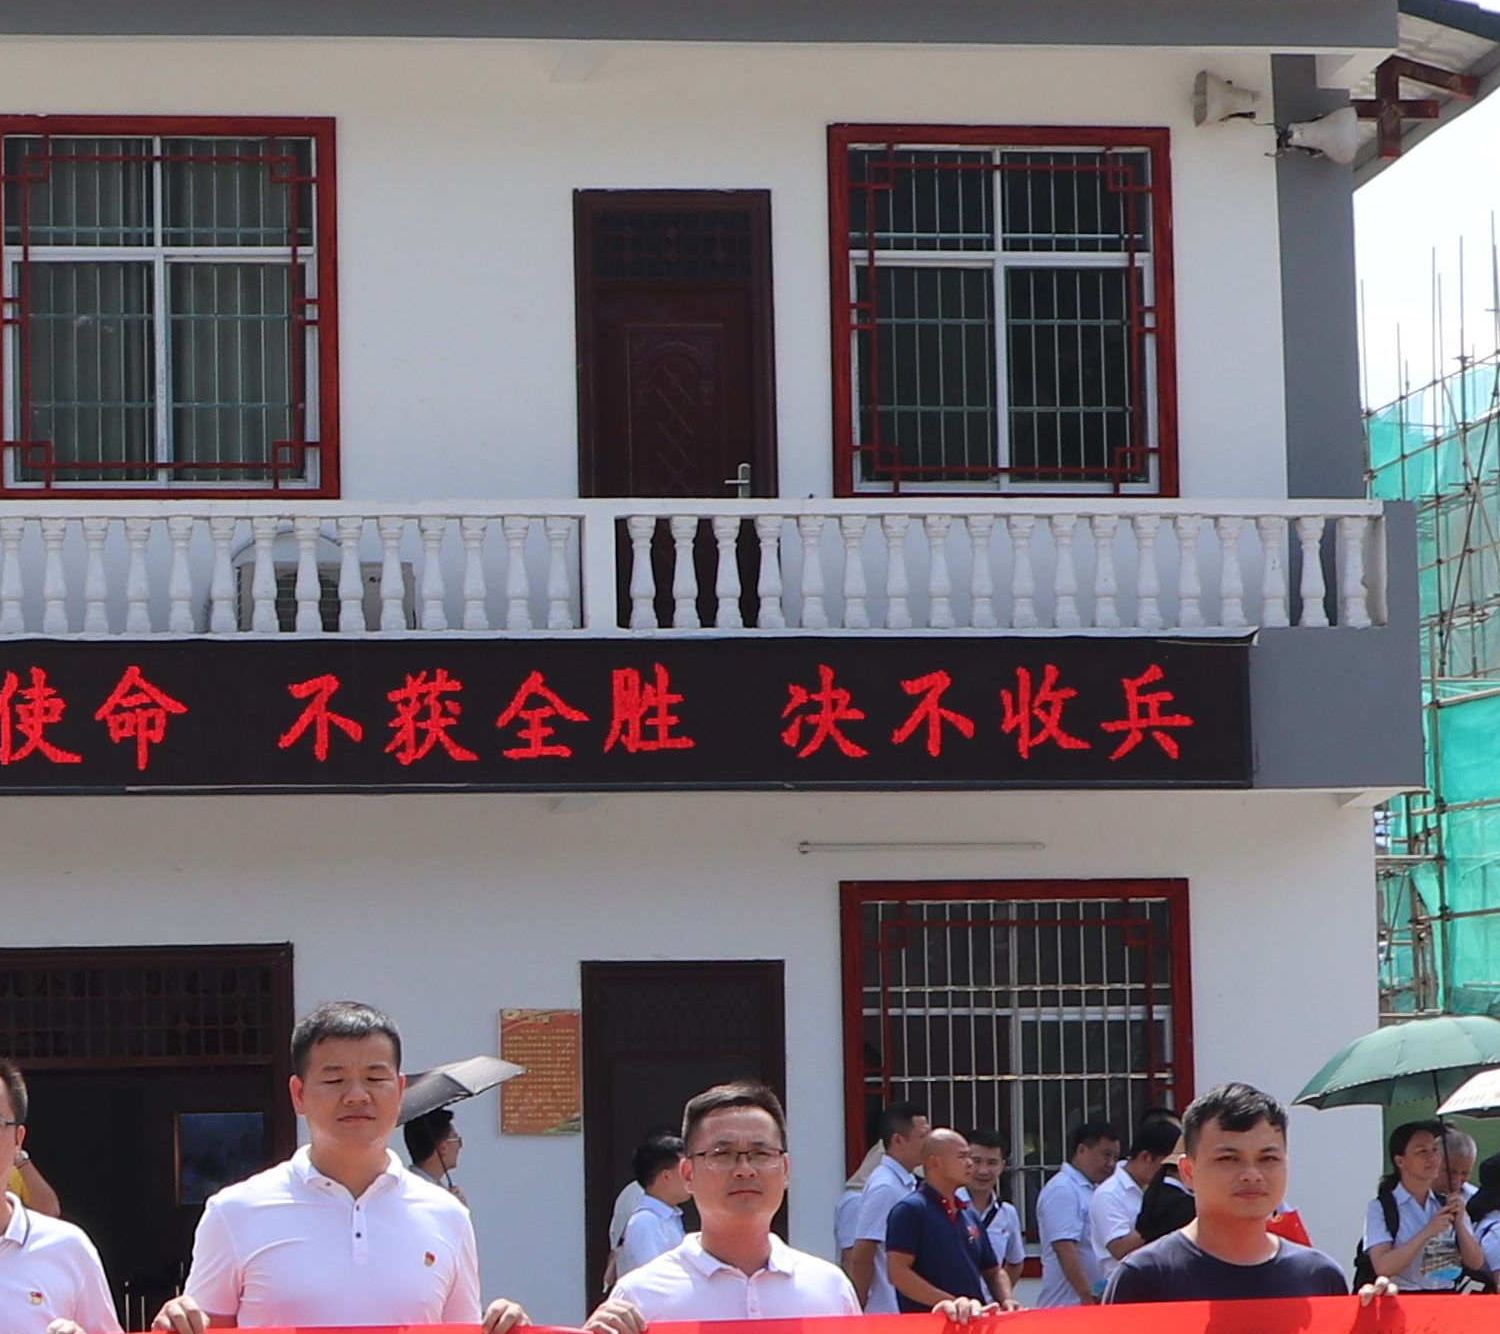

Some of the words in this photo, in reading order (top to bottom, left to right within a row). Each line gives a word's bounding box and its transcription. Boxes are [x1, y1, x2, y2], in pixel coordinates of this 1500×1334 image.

[278, 663, 695, 767] 不获全胜
[781, 663, 1194, 761] 决不收兵
